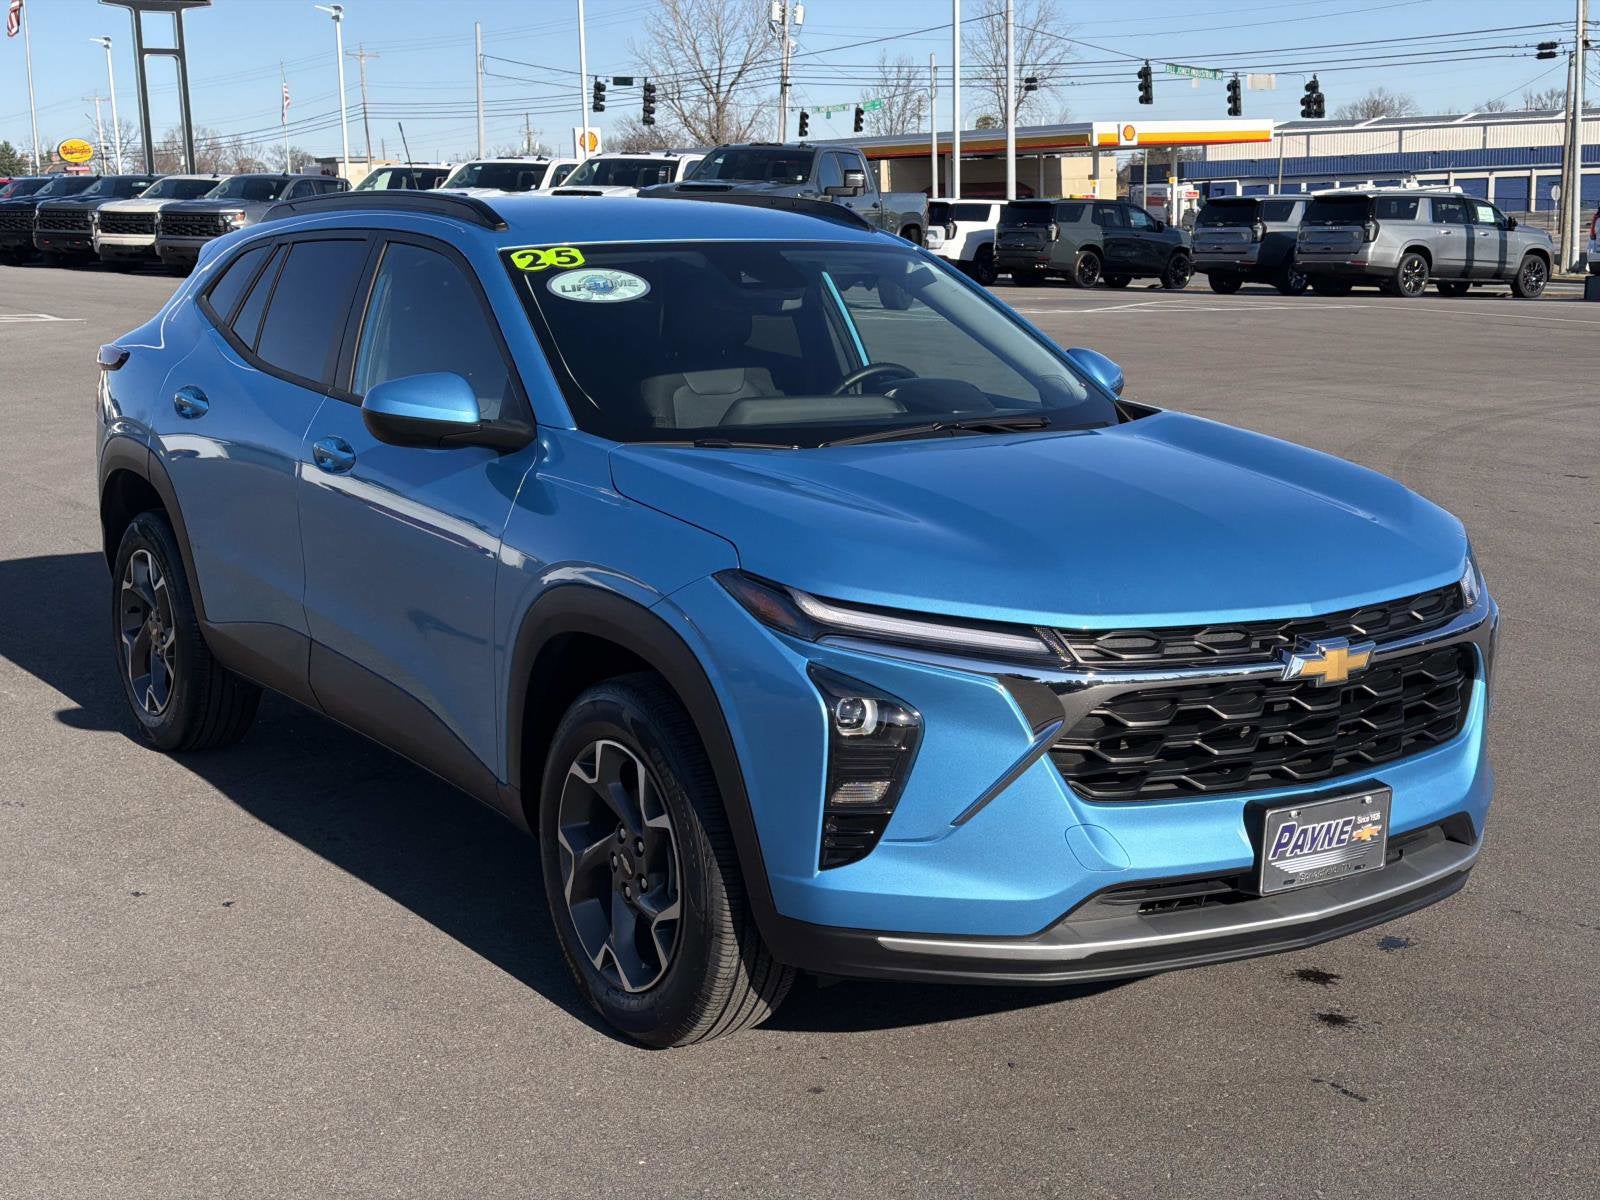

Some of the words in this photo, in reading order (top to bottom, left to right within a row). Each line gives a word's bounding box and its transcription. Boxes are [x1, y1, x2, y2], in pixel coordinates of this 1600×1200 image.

[516, 249, 580, 268] 25
[560, 277, 640, 293] LIFETIME
[1356, 814, 1370, 824] Since
[1268, 815, 1356, 860] PAYNE
